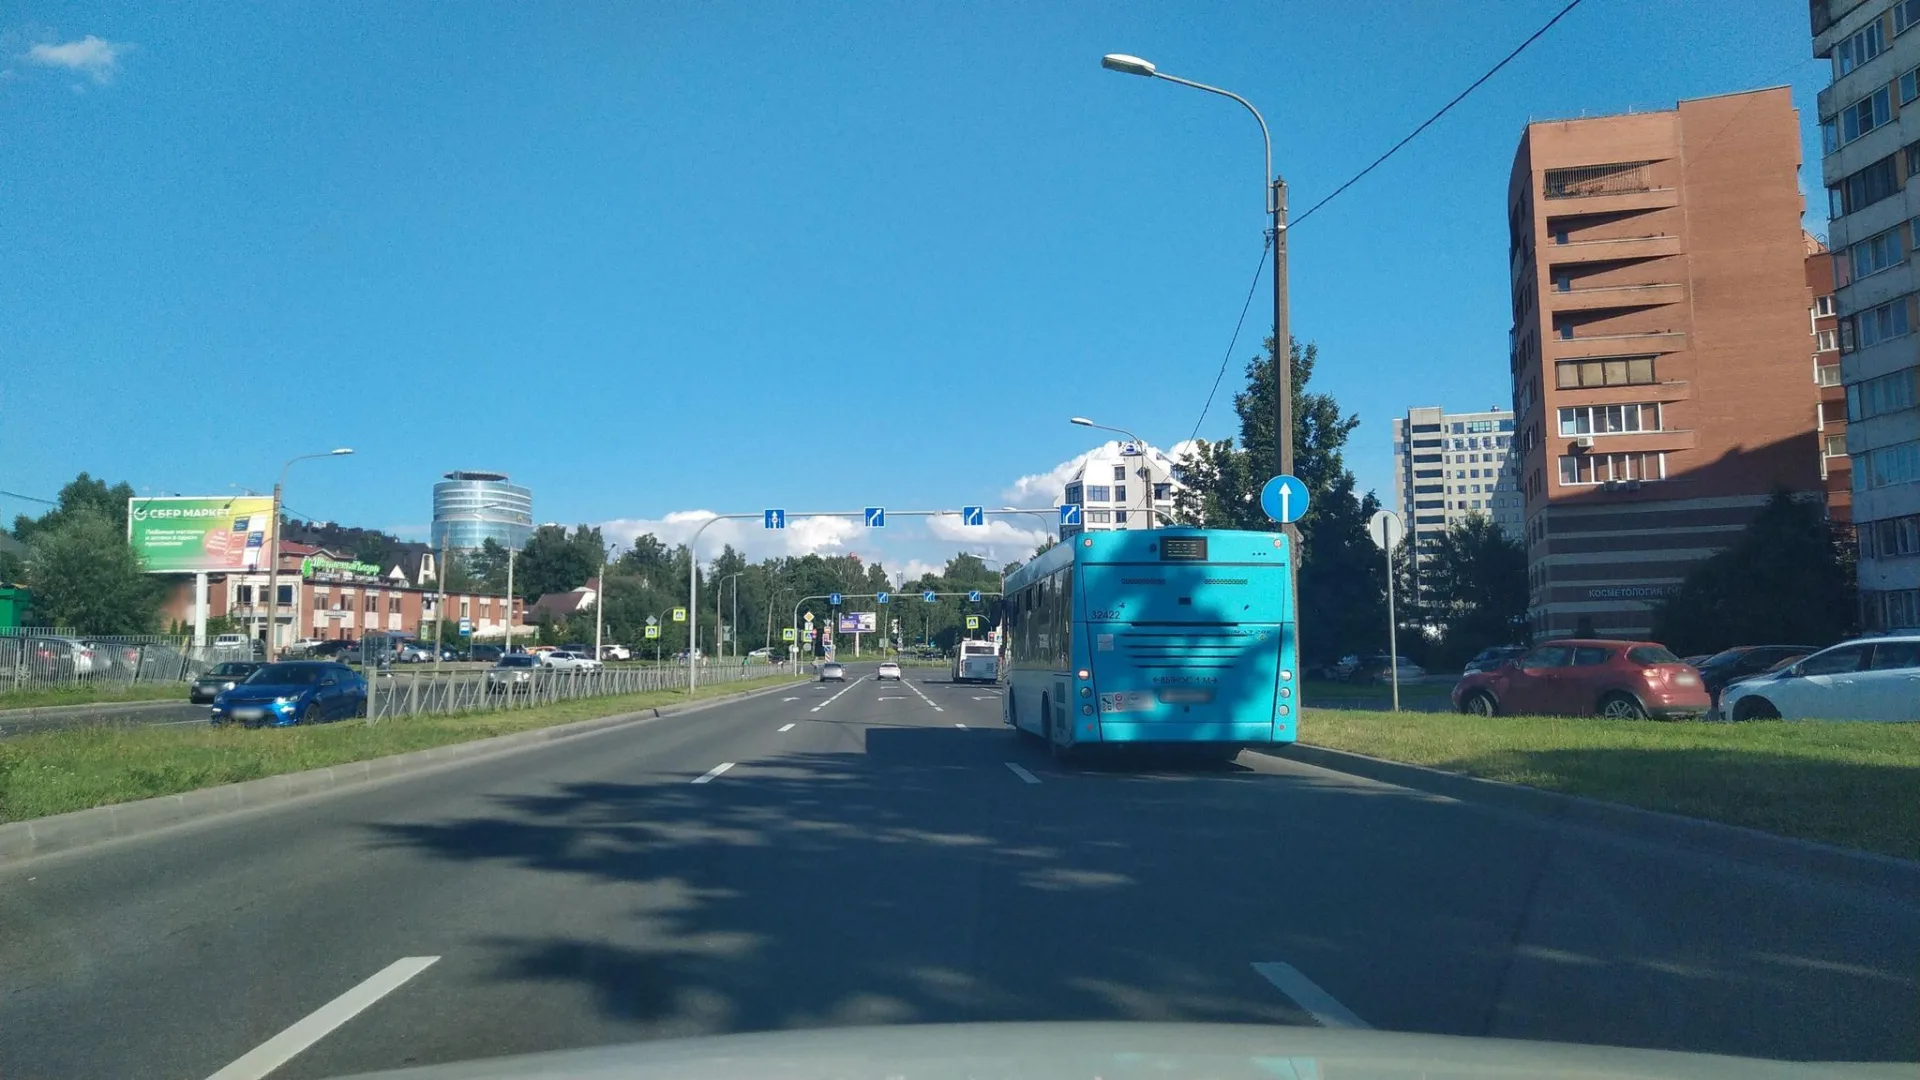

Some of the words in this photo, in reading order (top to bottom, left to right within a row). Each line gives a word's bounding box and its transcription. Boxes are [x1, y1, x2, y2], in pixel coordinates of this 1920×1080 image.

[150, 509, 181, 519] СБЕР
[183, 507, 231, 518] МАРКЕТ
[1589, 586, 1663, 598] КОСМЕТОЛОГИЯ
[1091, 610, 1121, 620] 32422
